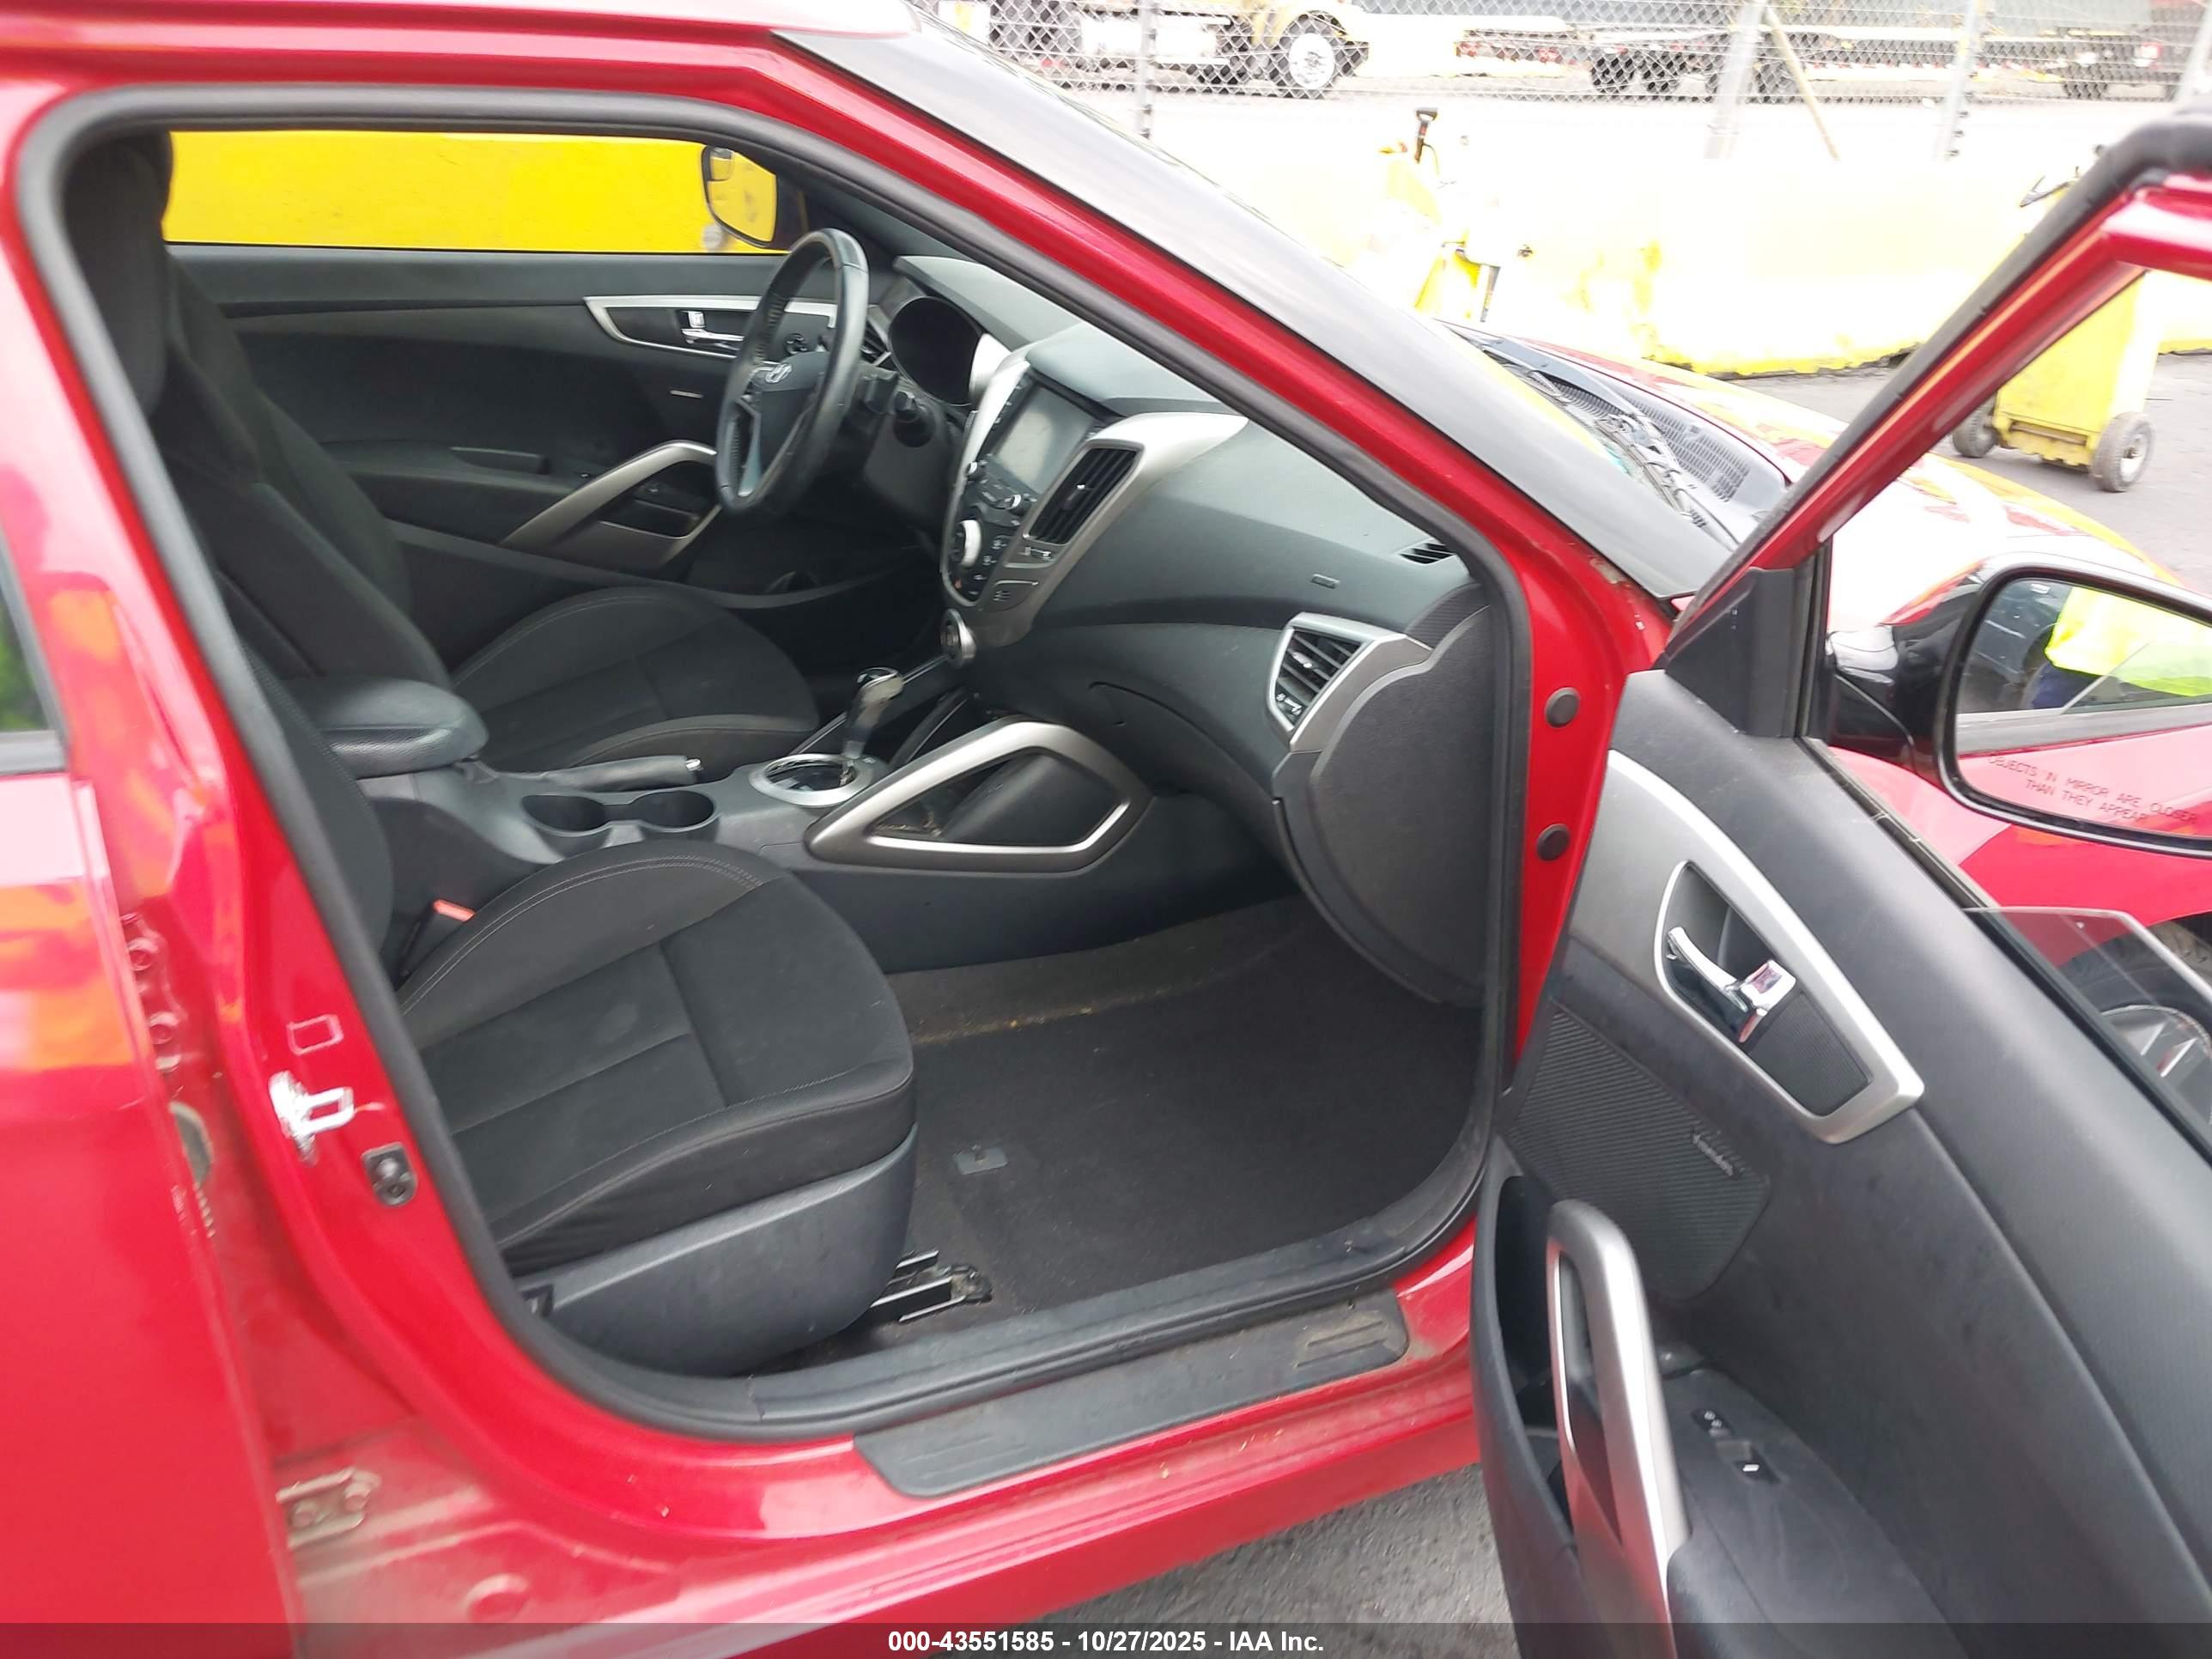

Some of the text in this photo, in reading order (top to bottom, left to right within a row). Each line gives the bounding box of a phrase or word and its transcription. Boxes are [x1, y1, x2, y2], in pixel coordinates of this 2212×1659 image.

[1988, 756, 2038, 776] OBJECTS
[2045, 772, 2057, 782] IN
[2066, 777, 2109, 797] MIRROR
[2117, 793, 2142, 808] ARE
[2027, 779, 2055, 795] THAN
[2063, 789, 2094, 807] THEY
